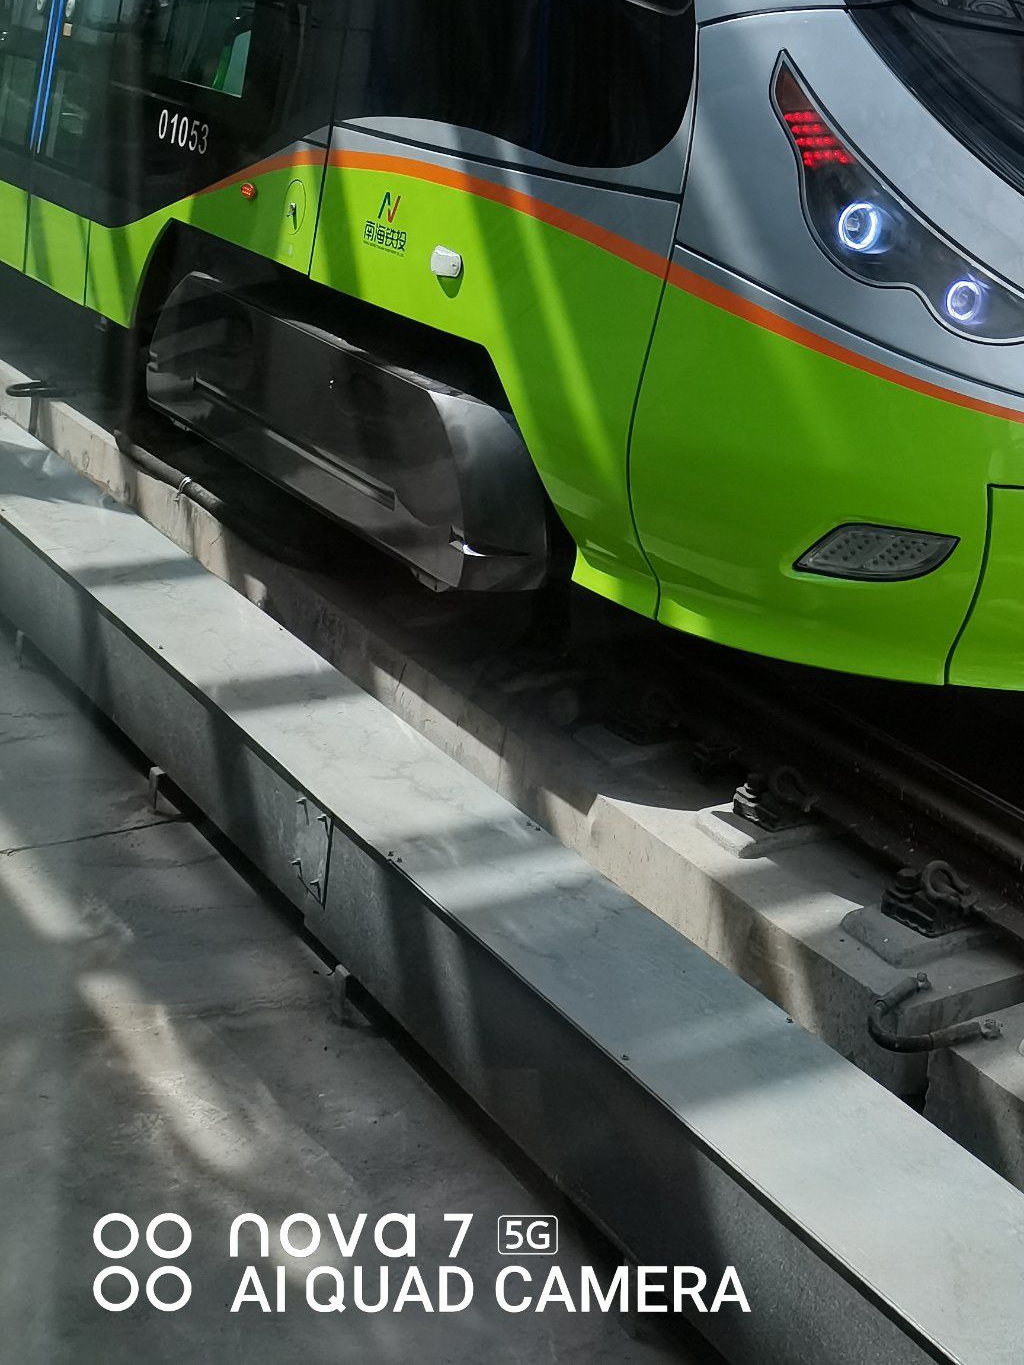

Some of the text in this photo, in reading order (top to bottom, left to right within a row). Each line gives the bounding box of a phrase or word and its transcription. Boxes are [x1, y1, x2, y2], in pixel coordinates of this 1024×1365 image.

[158, 109, 210, 155] 01053
[364, 220, 407, 252] 南海铁投
